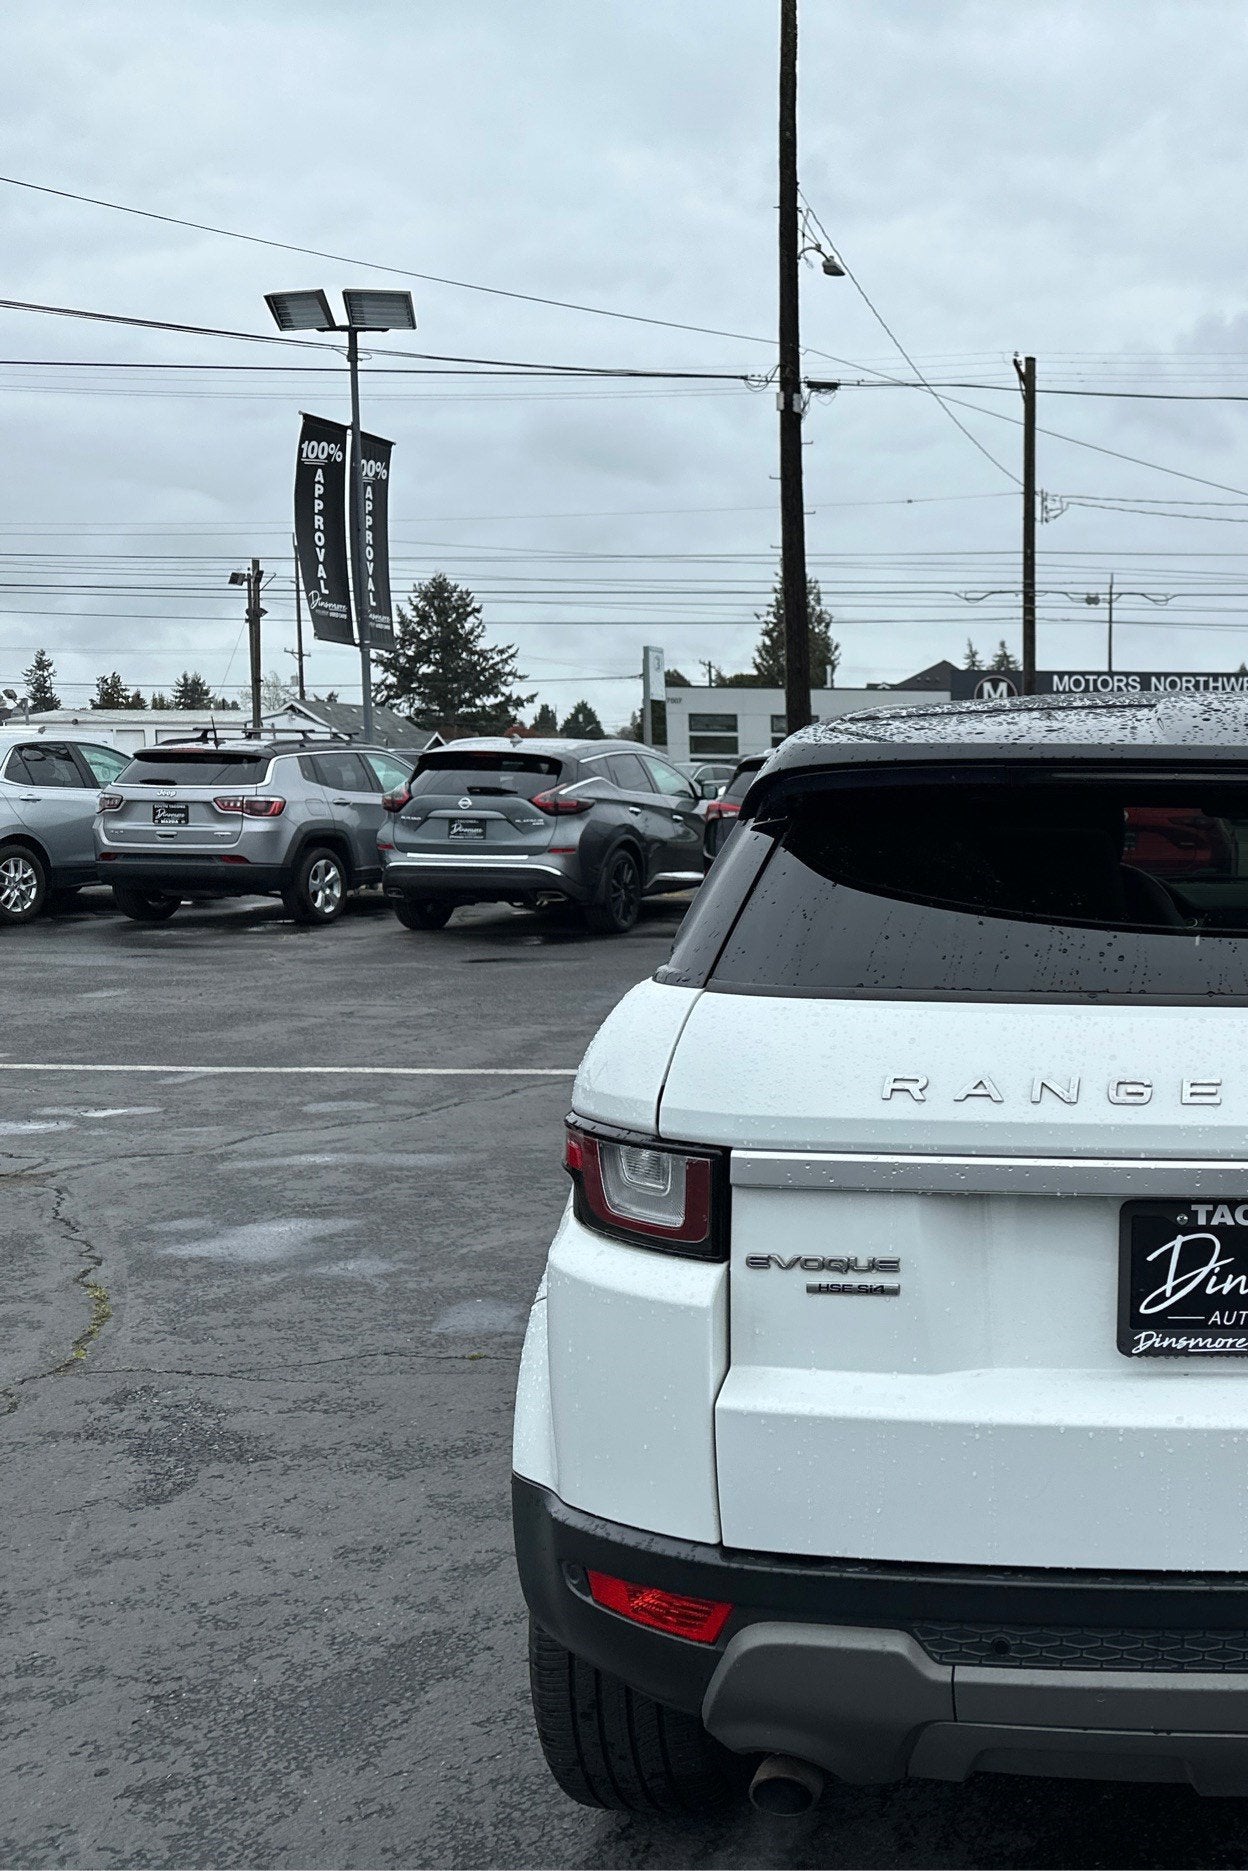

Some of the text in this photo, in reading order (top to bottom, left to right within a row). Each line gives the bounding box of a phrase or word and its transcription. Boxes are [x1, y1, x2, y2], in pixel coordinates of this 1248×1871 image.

[301, 440, 343, 463] 100%
[313, 468, 329, 595] APPROVAL
[365, 486, 377, 606] APPROVAL
[1052, 675, 1141, 692] MOTORS
[157, 789, 177, 797] Jeep
[881, 1074, 1223, 1106] RANGE
[746, 1252, 900, 1274] EVOQUE
[818, 1283, 886, 1294] HSE Si4
